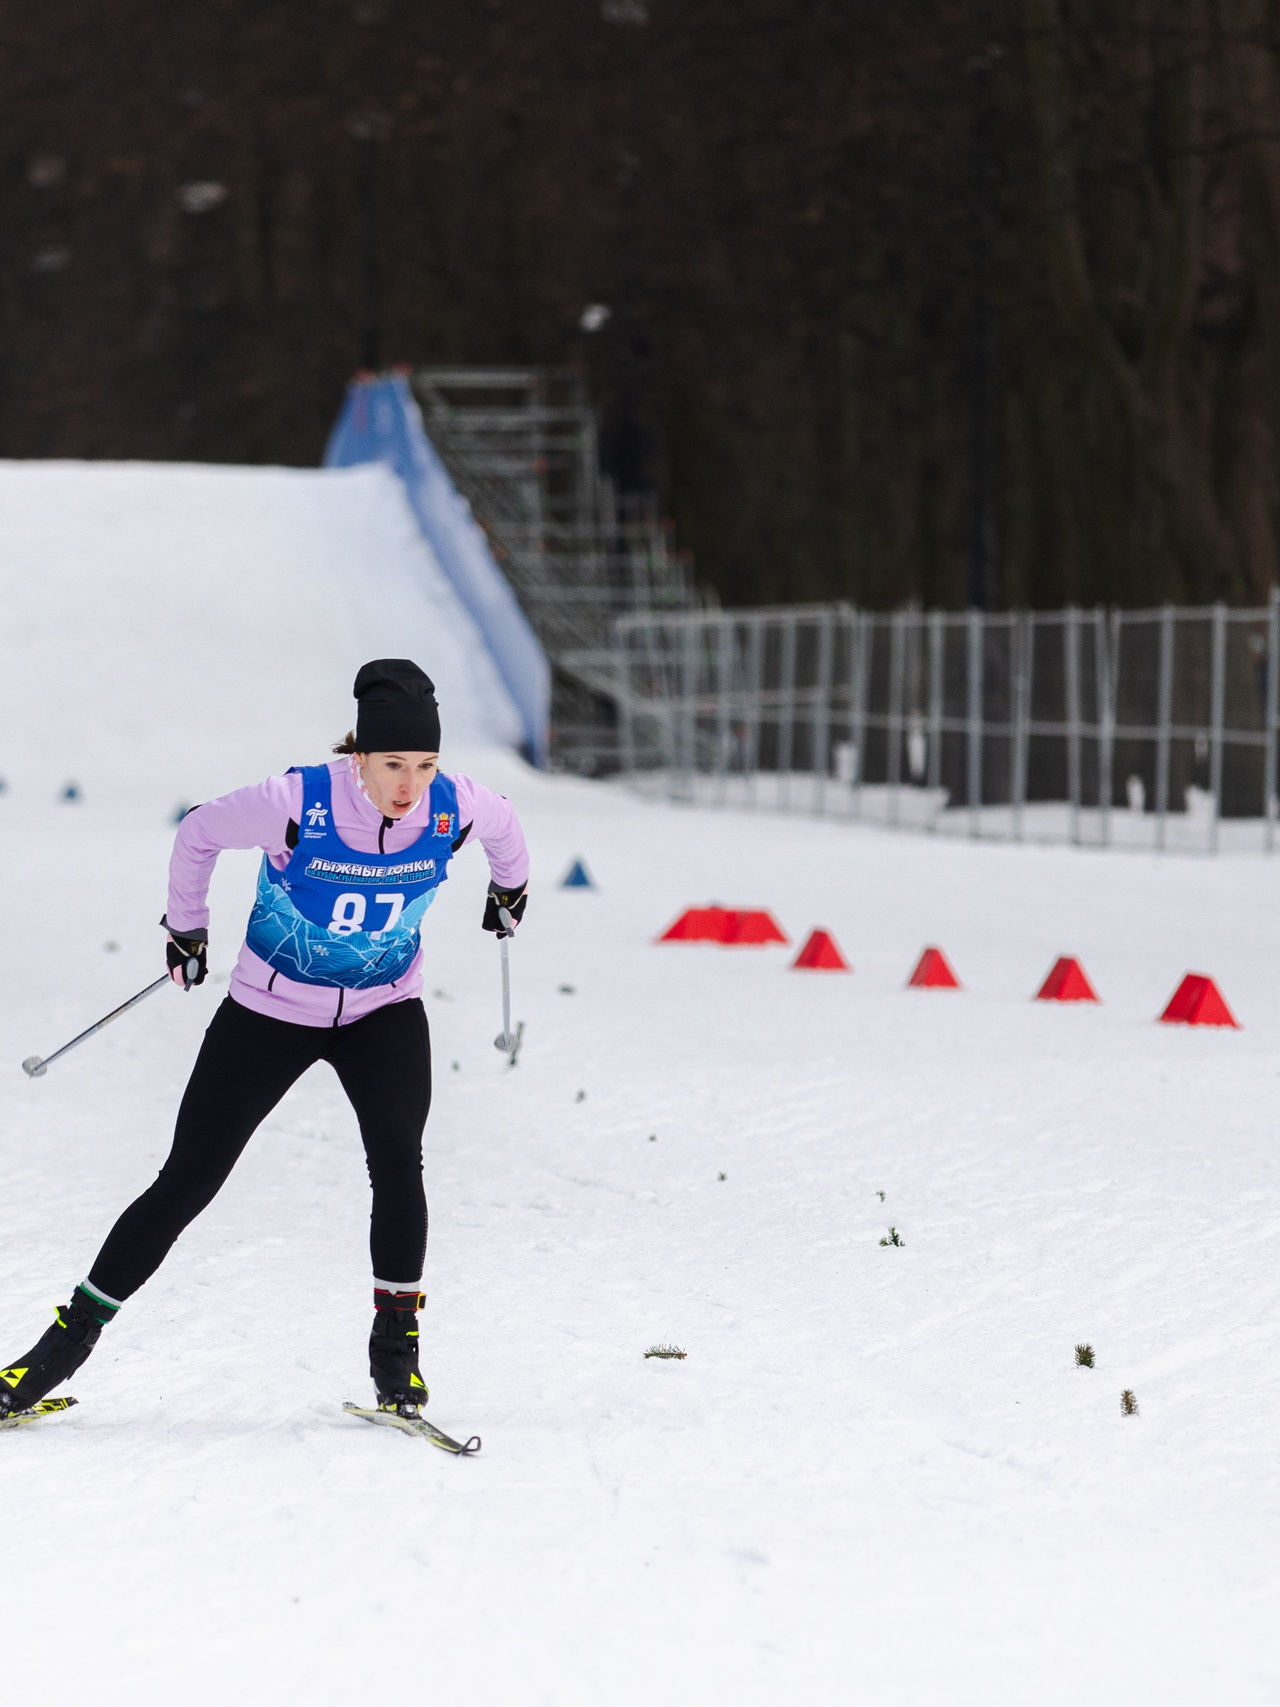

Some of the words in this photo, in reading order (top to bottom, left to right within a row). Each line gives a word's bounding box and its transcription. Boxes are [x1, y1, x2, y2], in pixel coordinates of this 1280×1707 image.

[310, 859, 385, 877] ЛЫЖНЫЕ
[387, 859, 434, 876] ГОНКИ
[328, 893, 405, 940] 87
